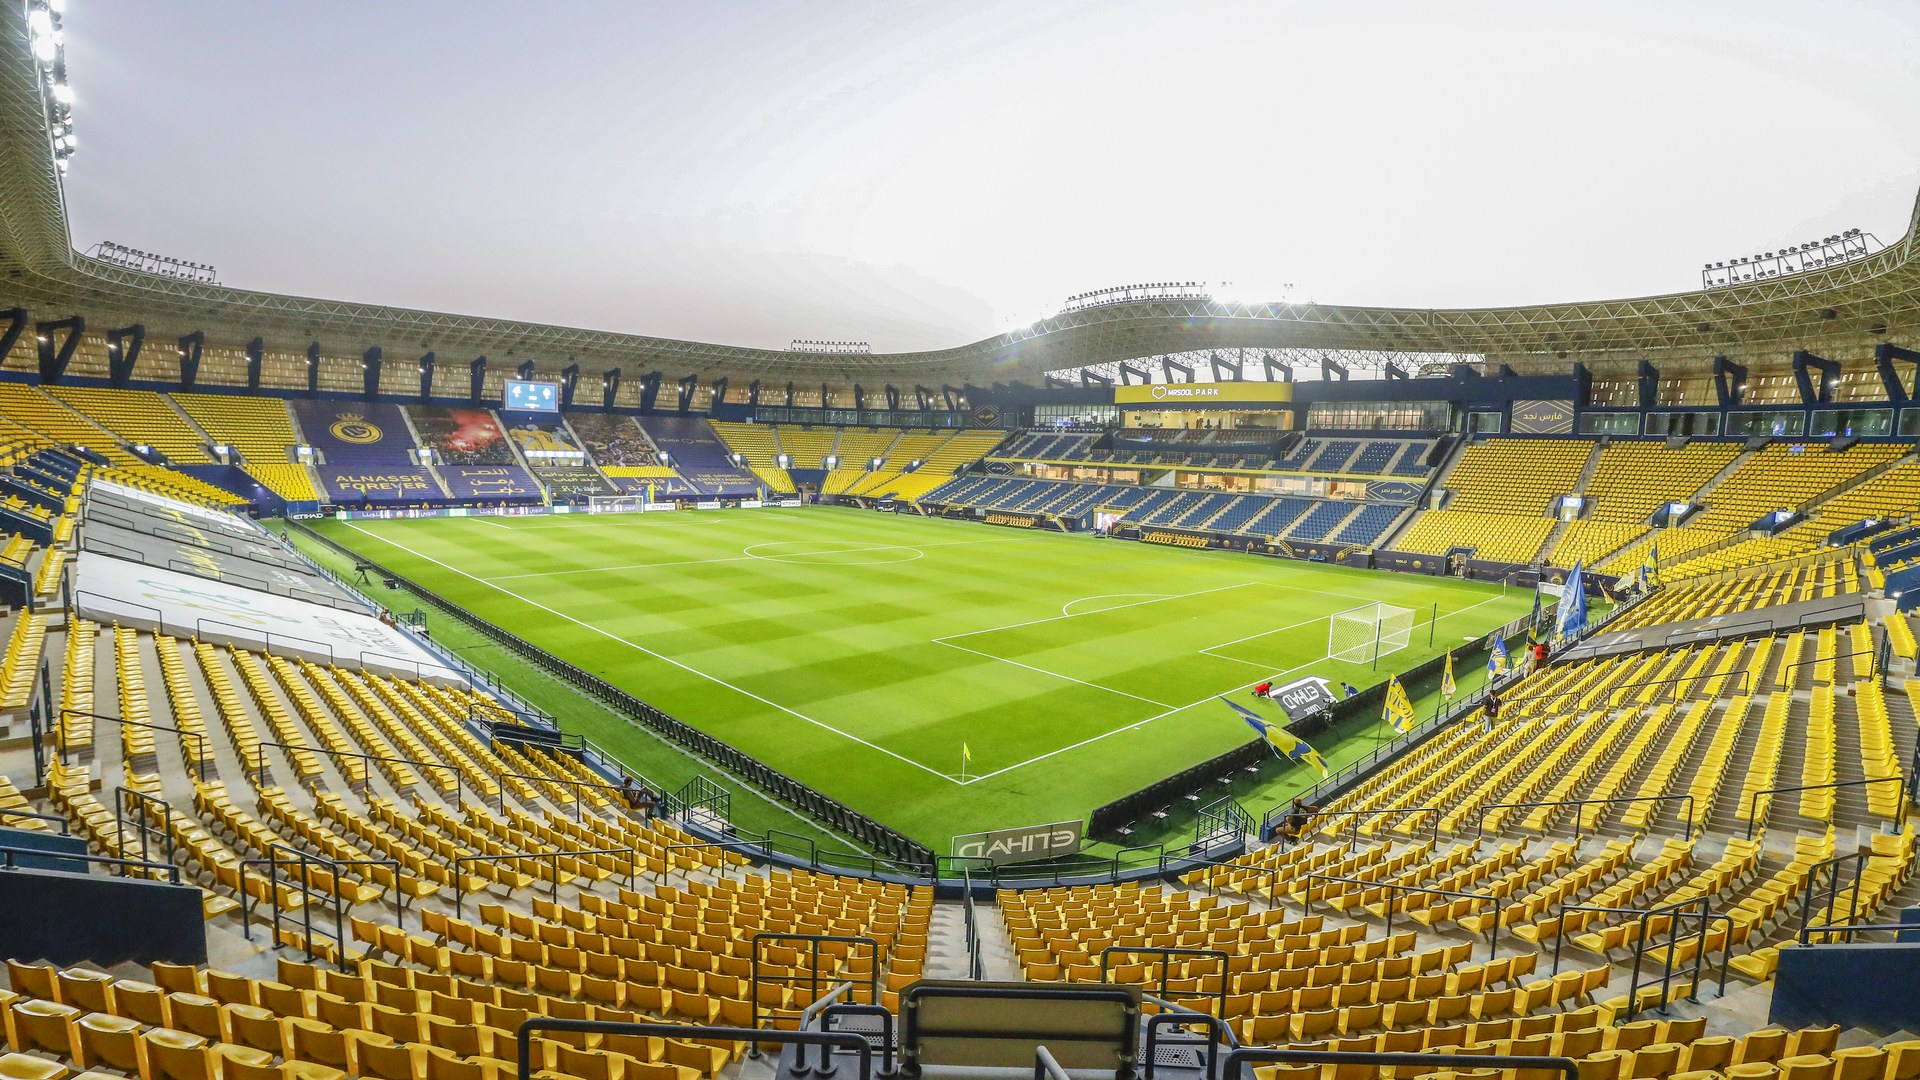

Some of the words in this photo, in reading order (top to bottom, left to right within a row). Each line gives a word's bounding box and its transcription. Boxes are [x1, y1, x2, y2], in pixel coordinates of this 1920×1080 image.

[1195, 388, 1219, 396] PARK
[1523, 412, 1537, 421] نجد
[1539, 412, 1563, 421] فارس
[340, 482, 429, 490] FOREVER
[1282, 685, 1320, 710] ETIHAD
